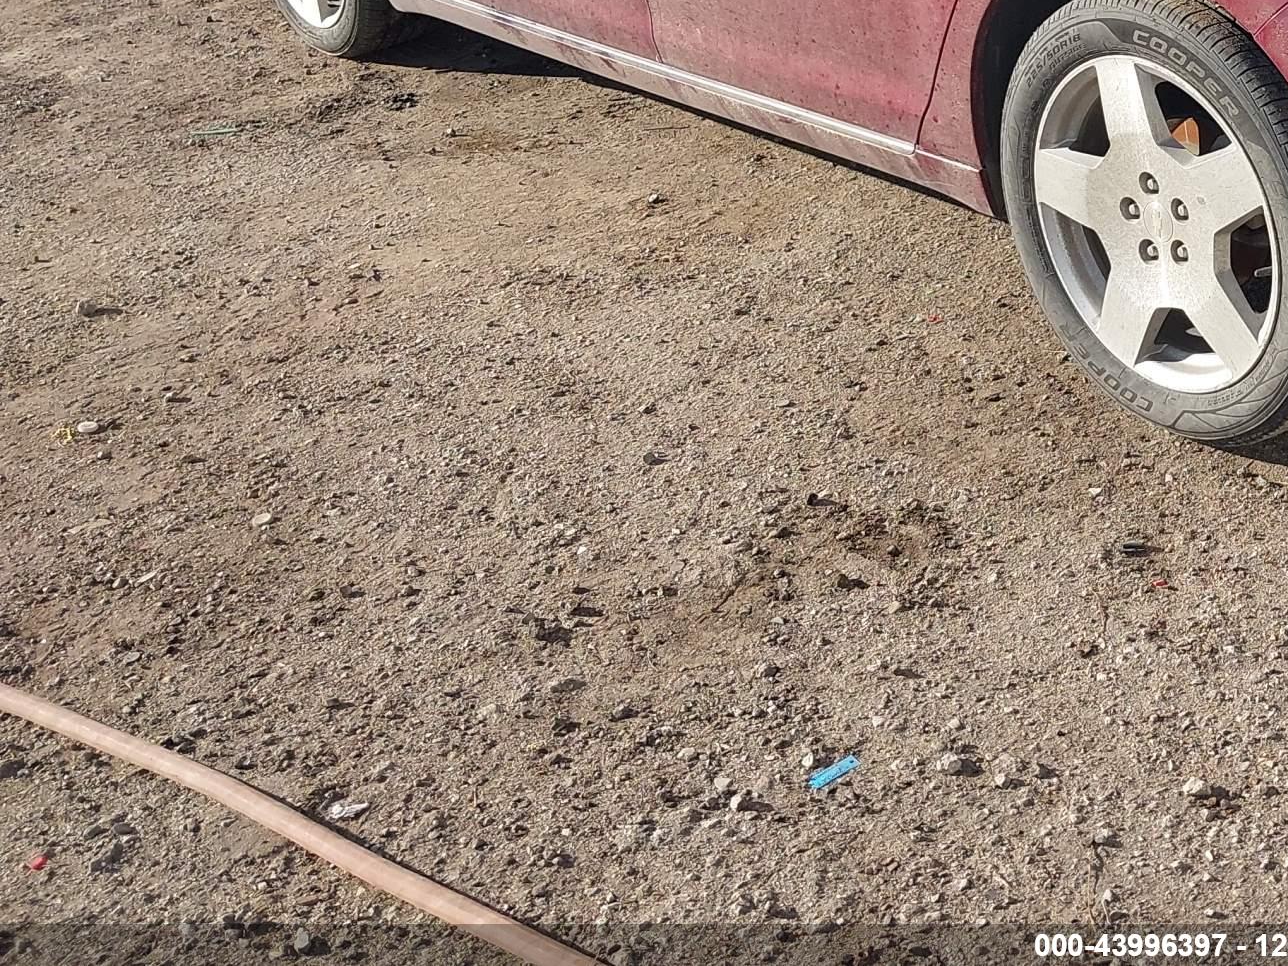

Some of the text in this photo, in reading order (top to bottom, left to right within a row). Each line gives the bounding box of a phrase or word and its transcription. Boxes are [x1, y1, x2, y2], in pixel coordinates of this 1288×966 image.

[1026, 33, 1081, 89] 225/50R18
[1132, 29, 1240, 116] COOPER
[1059, 324, 1154, 413] COOPER
